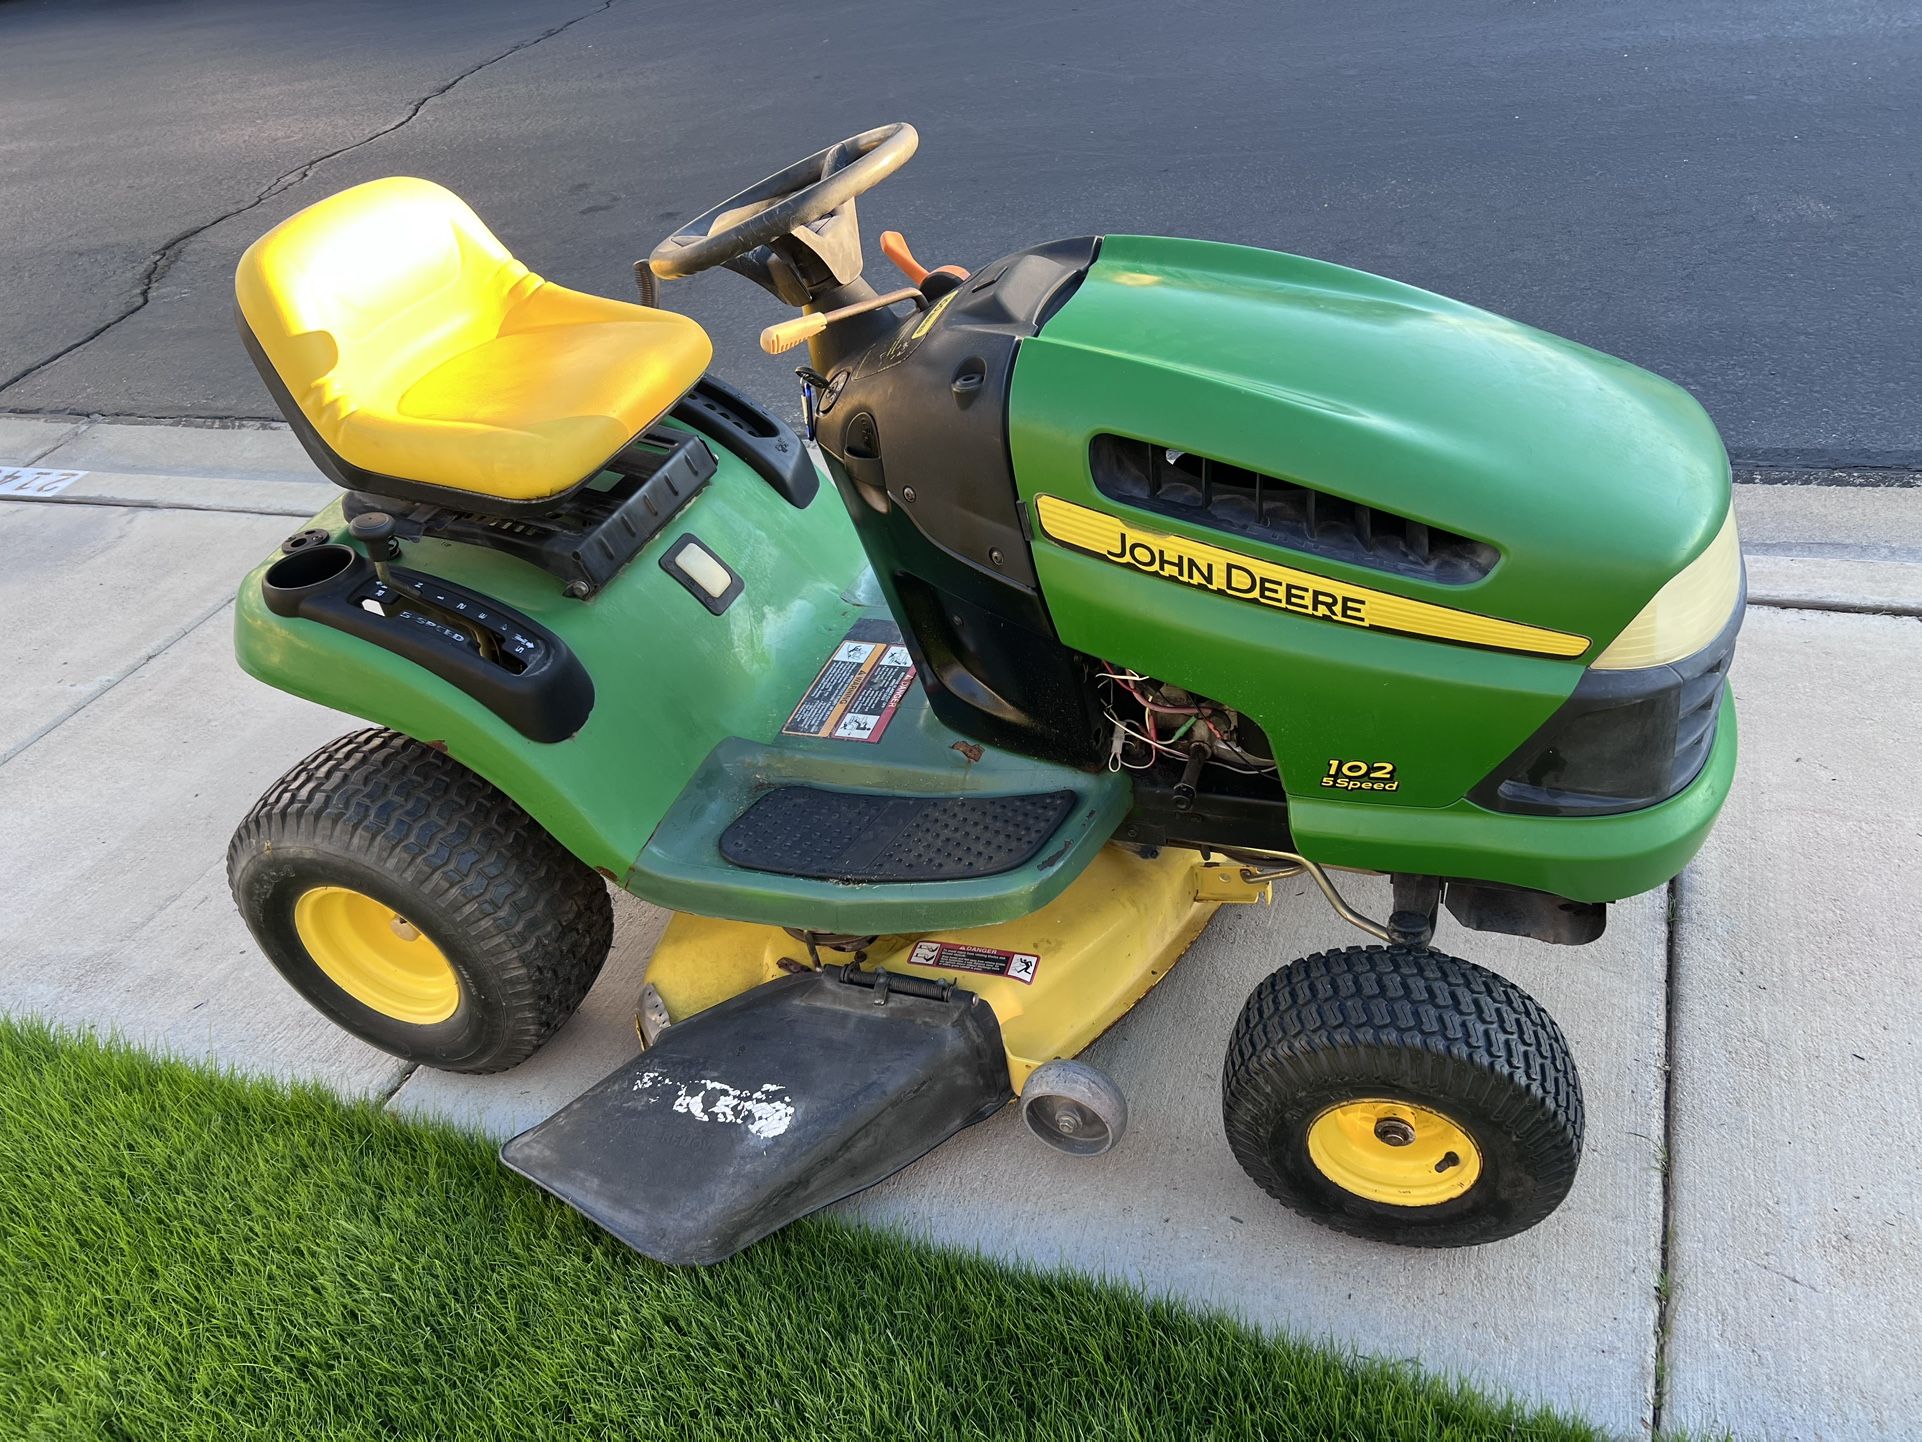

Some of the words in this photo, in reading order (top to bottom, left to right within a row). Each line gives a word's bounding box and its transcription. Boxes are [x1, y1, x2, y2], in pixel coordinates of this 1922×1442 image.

[1106, 532, 1214, 587] JOHN
[1225, 561, 1367, 623] DEERE
[839, 676, 864, 705] WARNING
[888, 680, 910, 708] DANGER
[1328, 759, 1395, 778] 102
[966, 945, 998, 954] DANGER
